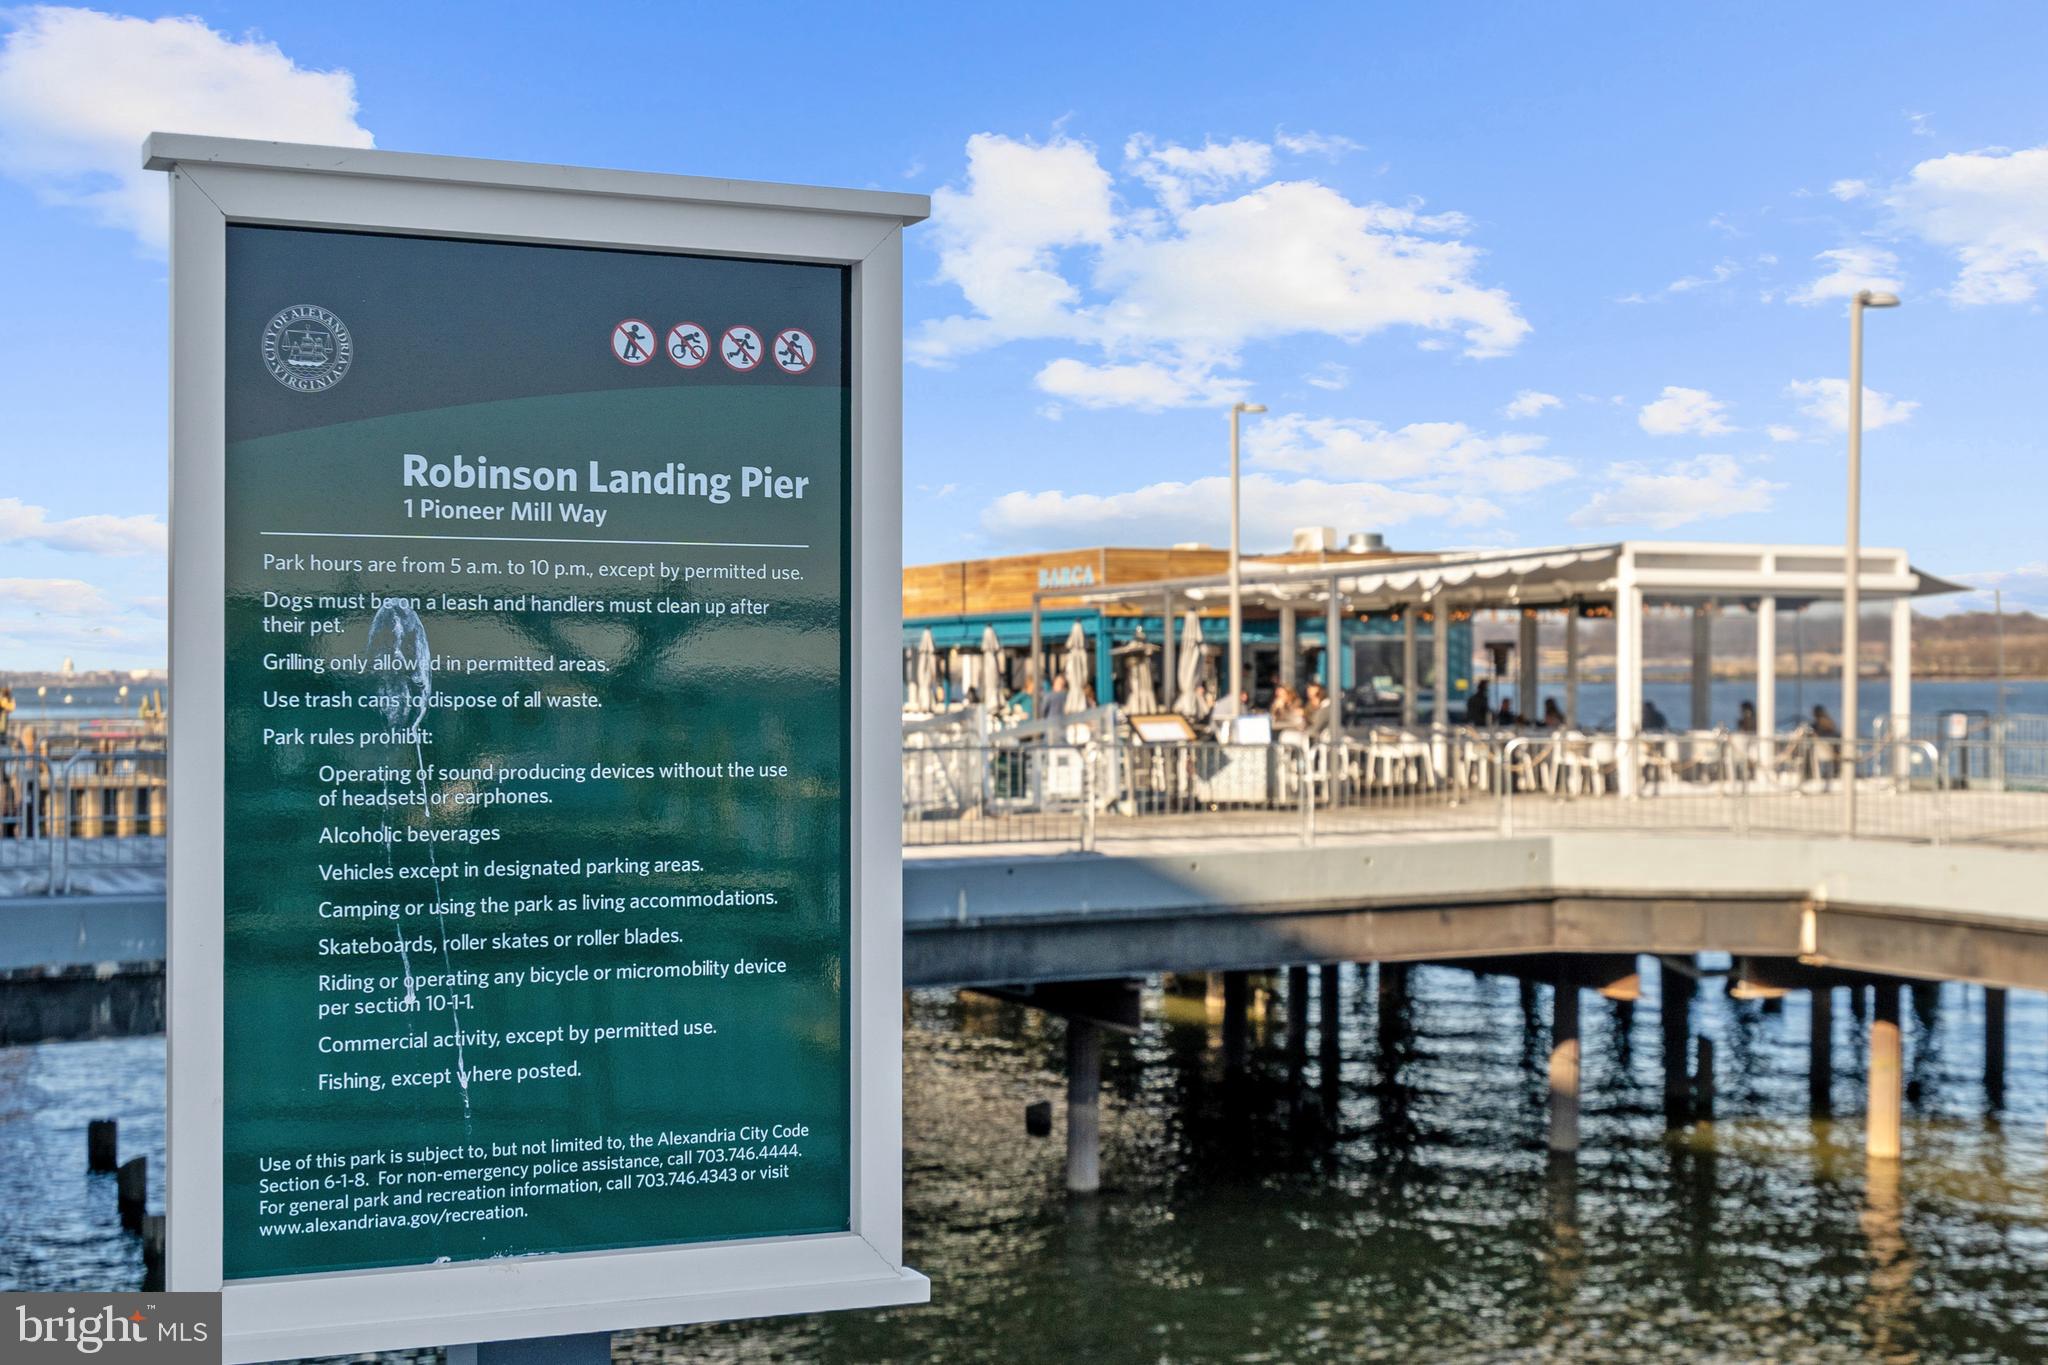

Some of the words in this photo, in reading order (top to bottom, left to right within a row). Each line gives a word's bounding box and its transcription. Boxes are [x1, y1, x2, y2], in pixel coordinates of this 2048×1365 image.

[264, 328, 277, 361] CITY
[273, 312, 288, 329] OF
[291, 307, 350, 365] ALEXANDRIA
[274, 364, 342, 389] VIRGINIA
[403, 454, 577, 492] Robinson
[589, 460, 731, 504] Landing
[741, 466, 809, 498] Pier
[403, 498, 412, 518] 1
[421, 498, 504, 520] Pioneer
[511, 501, 551, 521] Mill
[558, 502, 607, 527] Way
[264, 553, 304, 570] Park
[311, 554, 362, 571] hours
[367, 560, 396, 572] are
[401, 555, 444, 573] from
[450, 557, 461, 573] 5
[466, 562, 501, 574] a.m.
[507, 559, 525, 575] to
[529, 559, 549, 575] 10
[554, 564, 593, 579] p.m.,
[598, 562, 655, 580] except
[660, 561, 680, 581] by
[685, 563, 766, 581] permitted
[772, 568, 803, 580] use.
[1038, 565, 1093, 588] BARCA
[263, 591, 313, 612] Dogs
[319, 593, 365, 609] must
[371, 593, 393, 609] be
[399, 597, 420, 609] on
[426, 597, 436, 610] a
[442, 593, 487, 610] leash
[493, 594, 525, 611] and
[531, 594, 604, 612] handlers
[609, 598, 652, 613] must
[657, 596, 700, 613] clean
[705, 602, 725, 617] up
[730, 598, 769, 614] after
[262, 615, 305, 633] their
[310, 617, 344, 636] pet.
[263, 653, 325, 674] Grilling
[330, 653, 367, 674] only
[373, 654, 440, 671] allowd
[446, 655, 460, 670] in
[466, 654, 554, 674] permitted
[558, 657, 610, 671] areas.
[263, 690, 299, 707] Use
[304, 690, 352, 707] trash
[358, 696, 399, 707] cans
[407, 694, 421, 708] to
[428, 691, 496, 712] dispose
[501, 690, 519, 707] of
[524, 690, 541, 707] all
[546, 692, 602, 707] waste.
[263, 727, 304, 745] Park
[310, 727, 354, 744] rules
[360, 727, 432, 748] prohibit:
[319, 765, 411, 785] Operating
[416, 764, 434, 780] of
[438, 763, 493, 781] sound
[498, 763, 586, 783] producing
[590, 762, 654, 779] devices
[658, 761, 723, 778] without
[727, 761, 754, 777] the
[759, 765, 787, 777] use
[318, 789, 337, 806] of
[342, 789, 425, 806] headsets
[431, 792, 450, 805] or
[454, 787, 552, 807] earphones.
[319, 826, 402, 843] Alcoholic
[407, 825, 500, 844] beverages
[318, 863, 393, 880] Vehicles
[398, 862, 459, 881] except
[464, 861, 478, 877] in
[484, 857, 580, 879] designated
[586, 857, 650, 878] parking
[654, 860, 703, 872] areas.
[318, 900, 400, 920] Camping
[404, 903, 424, 915] or
[429, 898, 476, 918] using
[480, 896, 509, 913] the
[514, 894, 553, 916] park
[557, 898, 577, 911] as
[582, 893, 625, 912] living
[629, 889, 777, 909] accommodations.
[318, 935, 437, 956] Skateboards,
[442, 934, 487, 950] roller
[492, 932, 548, 949] skates
[553, 934, 572, 947] or
[577, 928, 619, 946] roller
[624, 927, 683, 944] blades.
[319, 973, 374, 993] Riding
[379, 976, 398, 989] or
[403, 970, 489, 991] operating
[493, 971, 525, 987] any
[530, 964, 588, 985] bicycle
[593, 968, 611, 980] or
[616, 959, 729, 979] micromobility
[734, 957, 786, 974] device
[318, 1002, 349, 1019] per
[354, 996, 420, 1014] section
[425, 994, 474, 1011] 10-1-1.
[318, 1031, 427, 1053] Commercial
[433, 1029, 500, 1048] activity,
[505, 1026, 563, 1045] except
[569, 1024, 589, 1044] by
[594, 1019, 678, 1043] permitted
[683, 1022, 716, 1035] use.
[318, 1072, 385, 1091] Fishing,
[391, 1068, 451, 1088] except
[456, 1065, 512, 1083] where
[517, 1060, 581, 1083] posted.
[260, 1156, 291, 1172] Use
[295, 1153, 312, 1170] of
[315, 1153, 345, 1168] this
[350, 1149, 385, 1169] park
[390, 1149, 402, 1163] is
[407, 1145, 463, 1165] subject
[467, 1144, 487, 1159] to,
[492, 1142, 517, 1157] but
[522, 1140, 546, 1154] not
[551, 1135, 602, 1153] limited
[606, 1136, 625, 1150] to,
[629, 1133, 653, 1148] the
[657, 1128, 735, 1146] Alexandria
[740, 1126, 768, 1142] City
[772, 1122, 808, 1138] Code
[259, 1176, 319, 1193] Section
[324, 1172, 369, 1189] 6-1-8.
[378, 1170, 403, 1185] For
[407, 1165, 529, 1183] non-emergency
[533, 1158, 578, 1178] police
[582, 1155, 663, 1171] assistance,
[667, 1149, 692, 1166] call
[696, 1143, 801, 1163] 703.746.4444.
[260, 1200, 285, 1215] For
[289, 1194, 348, 1216] general
[354, 1191, 388, 1211] park
[393, 1188, 421, 1205] and
[427, 1185, 505, 1203] recreation
[510, 1178, 602, 1197] information,
[606, 1174, 631, 1190] call
[636, 1167, 737, 1188] 703.746.4343
[741, 1169, 756, 1180] or
[759, 1164, 789, 1179] visit
[259, 1204, 528, 1236] www.alexandriava.gov/recreation.
